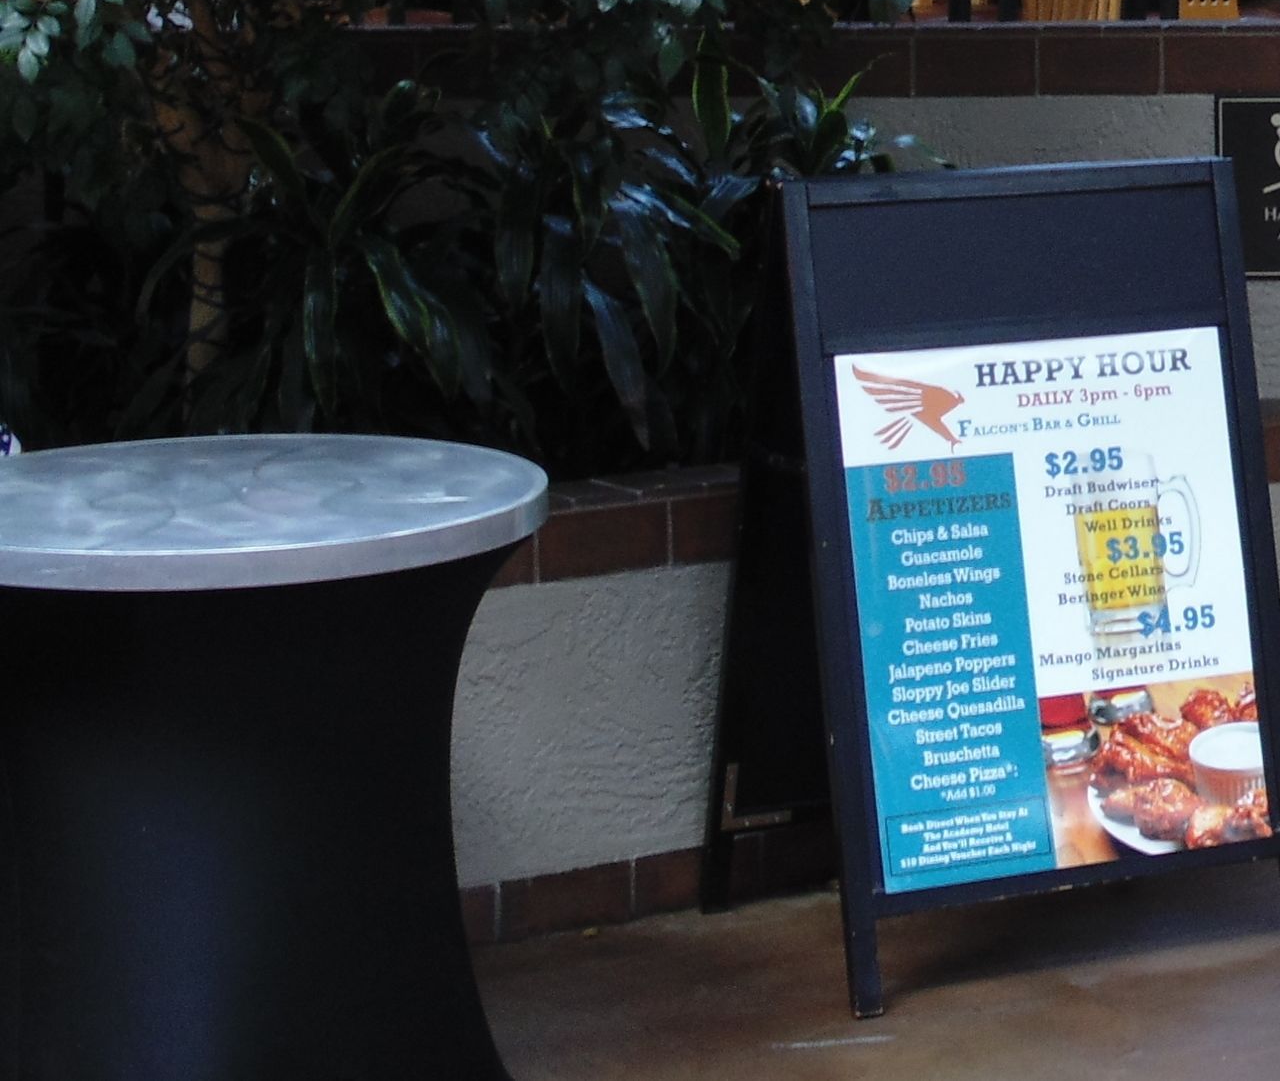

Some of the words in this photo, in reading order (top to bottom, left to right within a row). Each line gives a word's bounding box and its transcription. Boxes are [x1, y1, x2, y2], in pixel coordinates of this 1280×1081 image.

[974, 356, 1086, 388] HAPPY
[1096, 349, 1192, 377] HOUR
[1017, 389, 1075, 408] DAILY
[1080, 388, 1117, 405] 3pm
[1134, 384, 1172, 401] 6pm
[957, 419, 1029, 439] FALCON'S
[1032, 417, 1061, 431] BAR
[1065, 420, 1073, 428] &
[1076, 412, 1121, 427] GRILL
[1045, 446, 1124, 479] $2.95
[882, 461, 965, 493] $2.95
[1045, 482, 1083, 498] Draft
[1087, 478, 1159, 494] Budwiser
[866, 492, 1012, 523] APPETIZERS
[1066, 501, 1103, 516] Draft
[1108, 498, 1151, 512] Coors
[891, 528, 934, 547] Chips
[937, 525, 949, 541] &
[951, 523, 989, 540] Salsa
[1085, 518, 1118, 533] Well
[1122, 514, 1172, 530] Drinks
[901, 545, 983, 566] Guacamole
[1106, 531, 1185, 564] $3.95
[887, 571, 952, 591] Boneless
[953, 566, 1001, 584] Wings
[1064, 569, 1104, 584] Stone
[1108, 564, 1164, 580] Cellars
[919, 591, 973, 609] Nachos
[1057, 587, 1125, 606] Beringer
[1127, 583, 1166, 600] Wine
[905, 616, 950, 633] Potato
[952, 611, 992, 628] Skins
[1136, 604, 1216, 638] $4.95
[902, 638, 959, 656] Cheese
[961, 632, 998, 650] Fries
[1039, 651, 1092, 667] Mango
[1096, 639, 1182, 661] Margaritas
[888, 663, 952, 684] Jalapeno
[954, 653, 1016, 674] Poppers
[1091, 662, 1165, 682] Signature
[1168, 655, 1220, 672] Drinks
[892, 683, 944, 704] Sloppy
[946, 680, 970, 700] Joe
[972, 675, 1016, 693] Slider
[887, 708, 944, 725] Cheese
[946, 695, 1025, 719] Quesadilla
[915, 727, 959, 745] Street
[960, 722, 1003, 739] Tacos
[923, 744, 1000, 766] Bruschetta
[910, 773, 966, 790] Cheese
[969, 784, 996, 799] $1.00
[923, 831, 942, 842] The
[943, 824, 984, 840] Academy
[985, 821, 1009, 833] Hotel
[926, 818, 954, 830] Direct
[954, 814, 980, 826] When
[922, 842, 942, 853] And
[969, 834, 1004, 847] Receive
[950, 848, 987, 860] Voucher
[988, 843, 1010, 856] Each
[1011, 840, 1037, 854] Night
